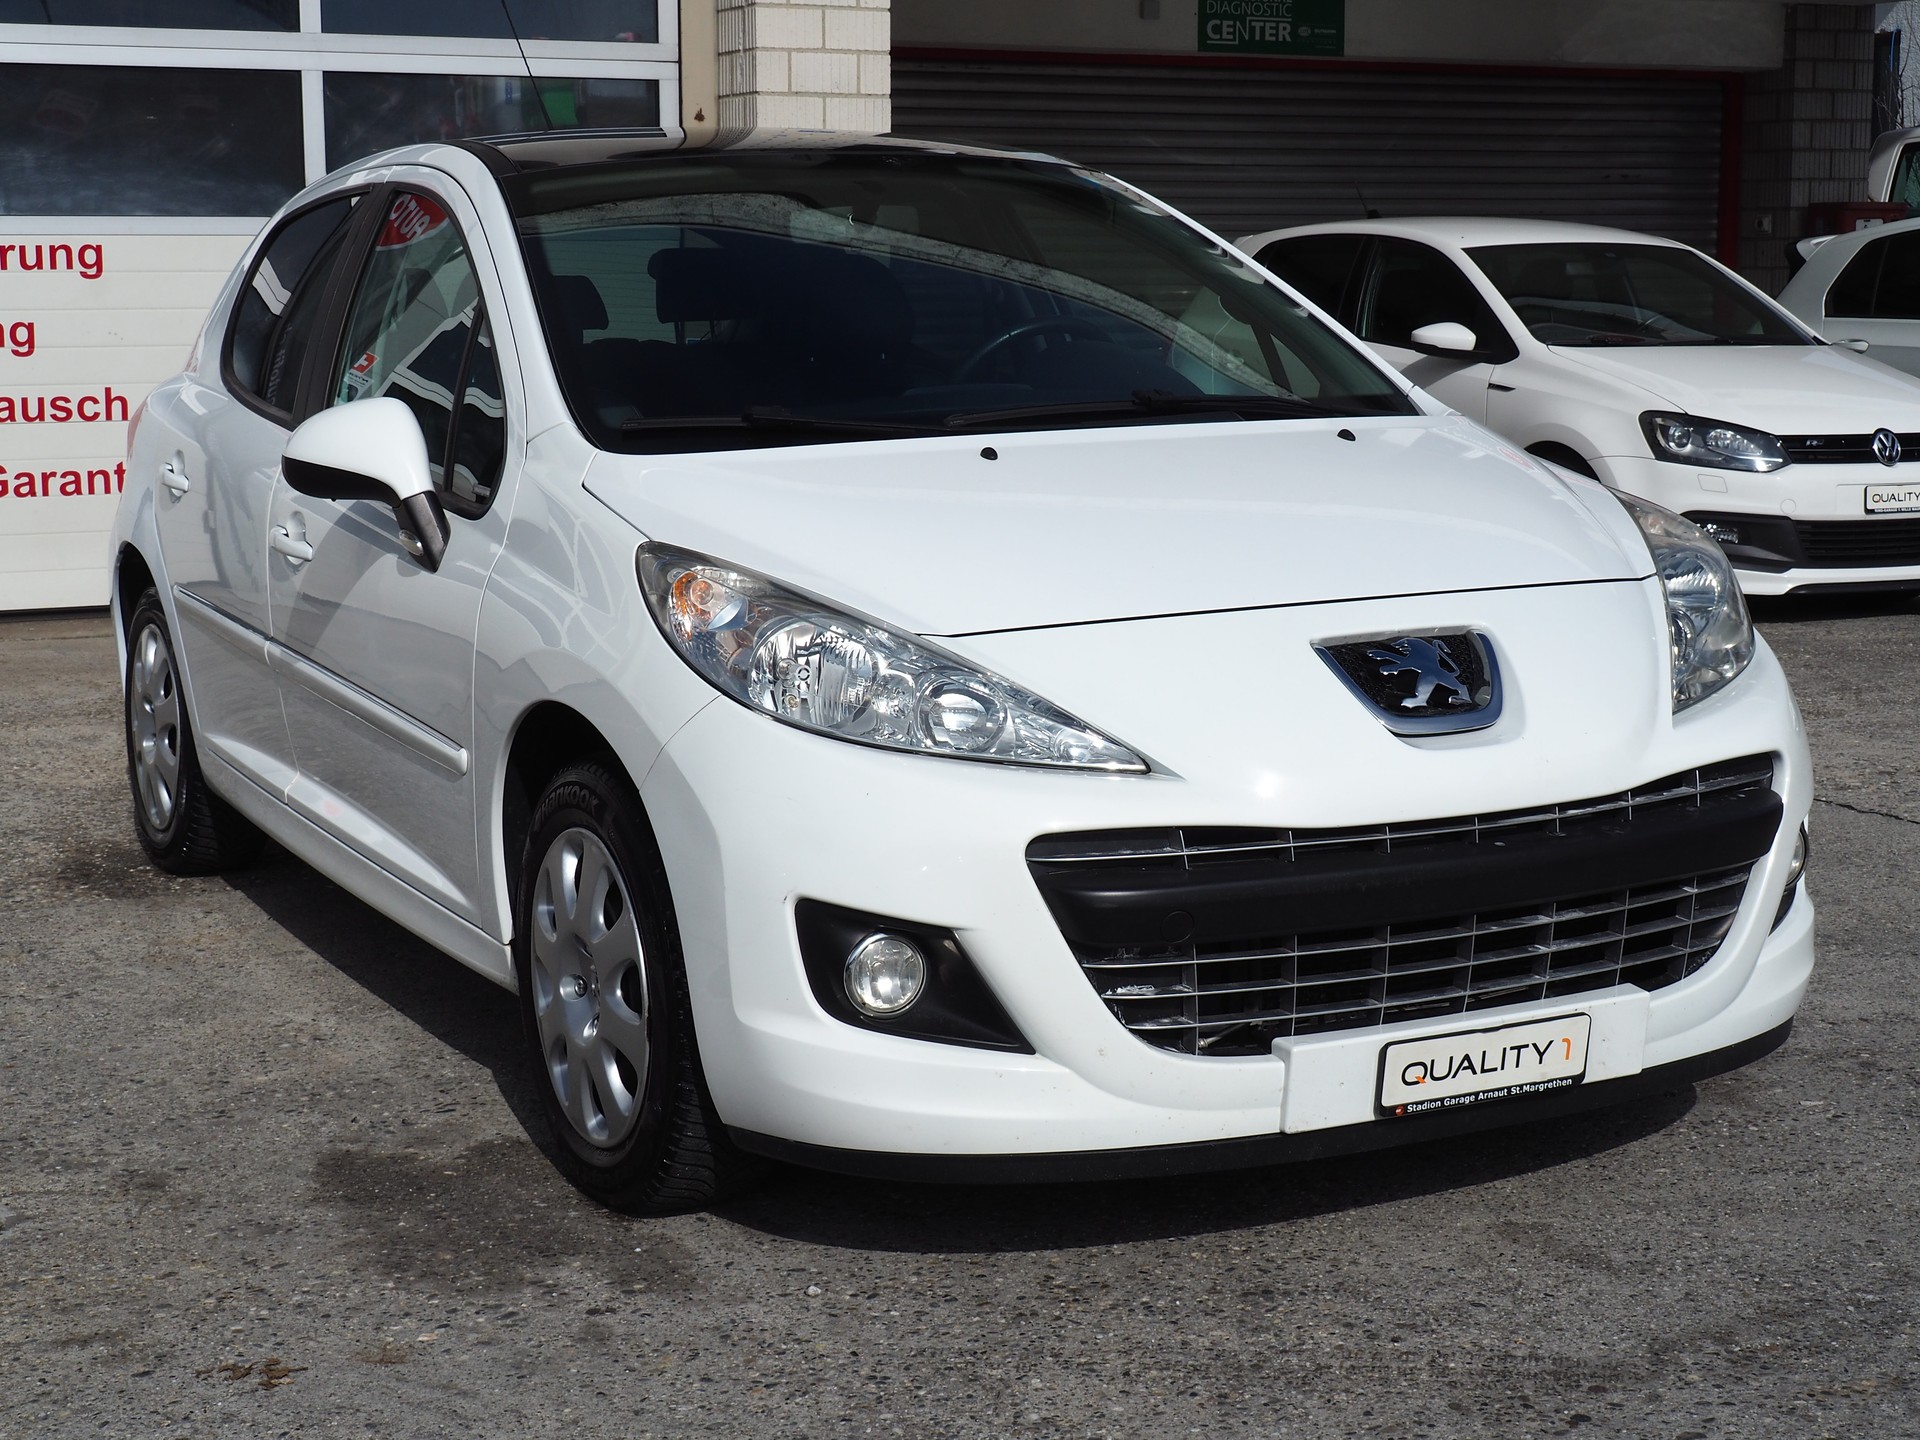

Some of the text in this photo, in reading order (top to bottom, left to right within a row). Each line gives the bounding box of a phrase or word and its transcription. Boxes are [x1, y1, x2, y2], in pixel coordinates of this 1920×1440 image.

[1206, 1, 1293, 17] DIAGNOSTIC
[1206, 18, 1293, 43] CENTER
[0, 243, 104, 280] rung
[0, 321, 36, 358] g
[1872, 491, 1920, 503] QUALITY
[1401, 1040, 1554, 1087] QUALITY
[1407, 1100, 1441, 1113] Stadion
[1444, 1095, 1475, 1107] Garage
[1478, 1088, 1508, 1100] Arnaut
